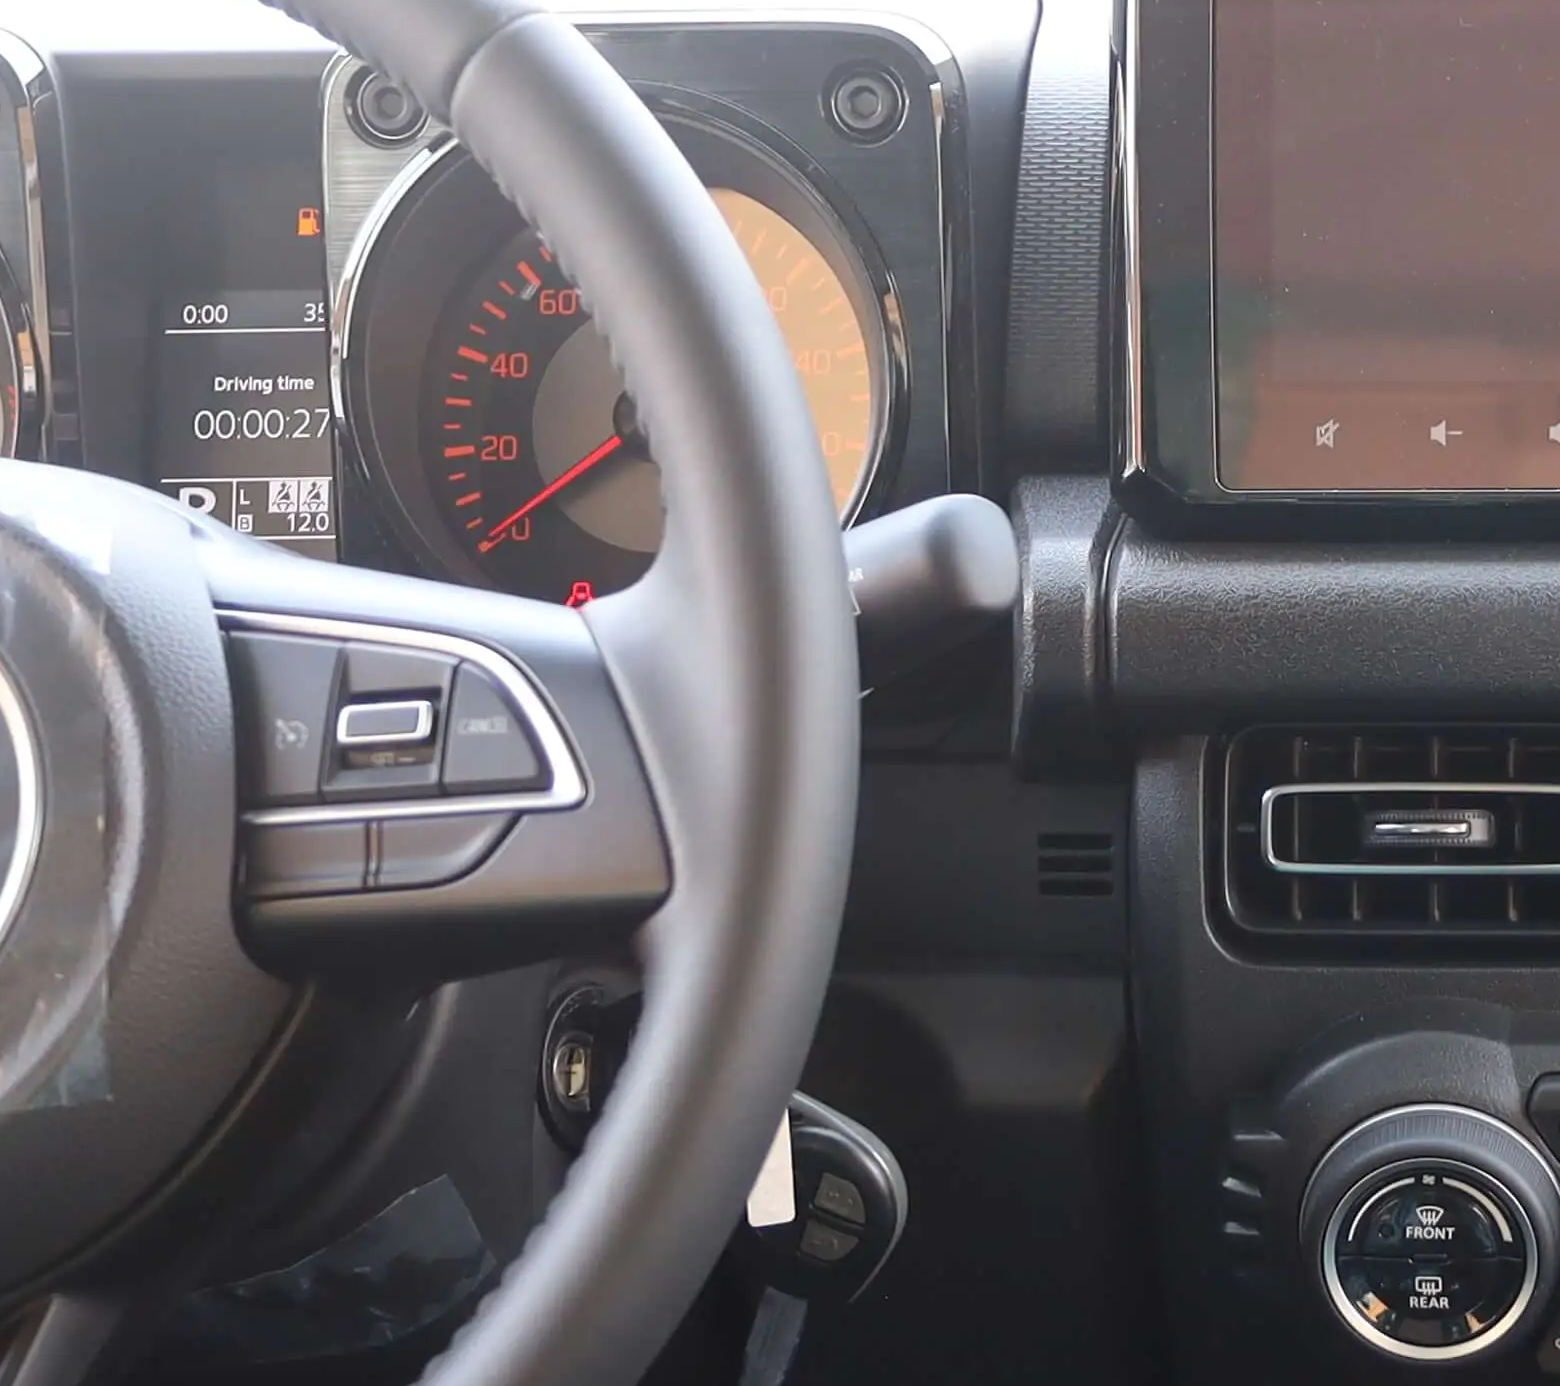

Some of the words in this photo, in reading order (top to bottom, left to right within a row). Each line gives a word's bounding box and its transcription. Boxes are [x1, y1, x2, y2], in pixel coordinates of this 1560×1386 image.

[539, 289, 577, 315] 60
[183, 304, 228, 324] 0:00
[490, 352, 528, 378] 40
[214, 376, 273, 395] Driving
[278, 375, 315, 391] time
[194, 408, 329, 439] 00:00:27
[480, 435, 518, 461] 20
[287, 513, 329, 532] 12.0
[1405, 1226, 1456, 1240] FRONT
[1409, 1296, 1450, 1309] REAR
